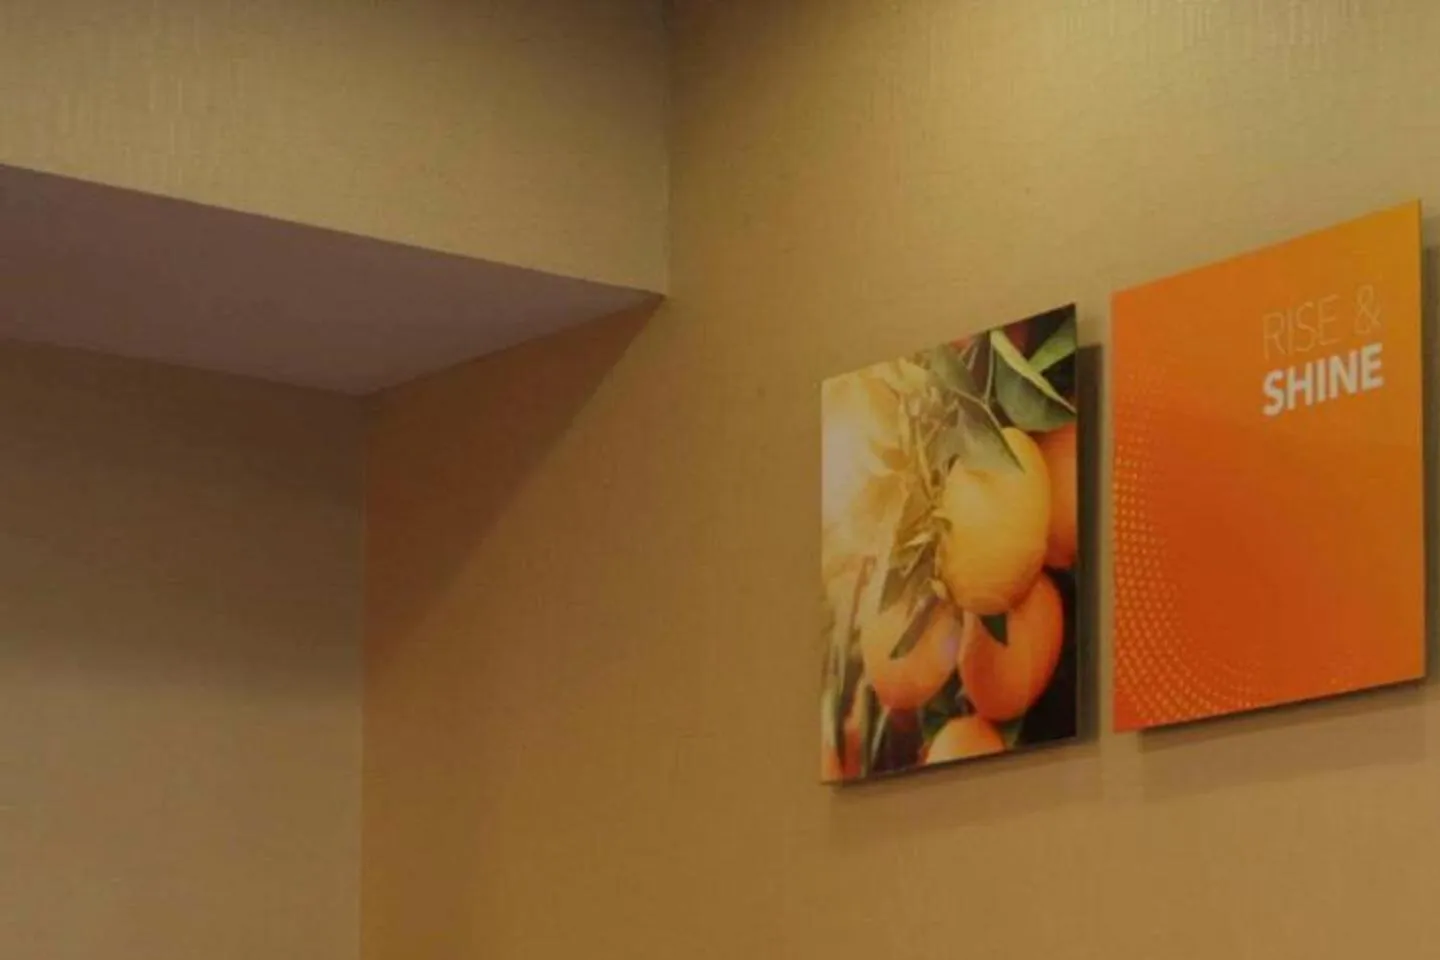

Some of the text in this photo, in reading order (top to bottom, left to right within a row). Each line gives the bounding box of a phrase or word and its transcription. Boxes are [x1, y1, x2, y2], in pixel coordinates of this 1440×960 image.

[1262, 284, 1382, 361] RISE &
[1262, 342, 1384, 417] SHINE
